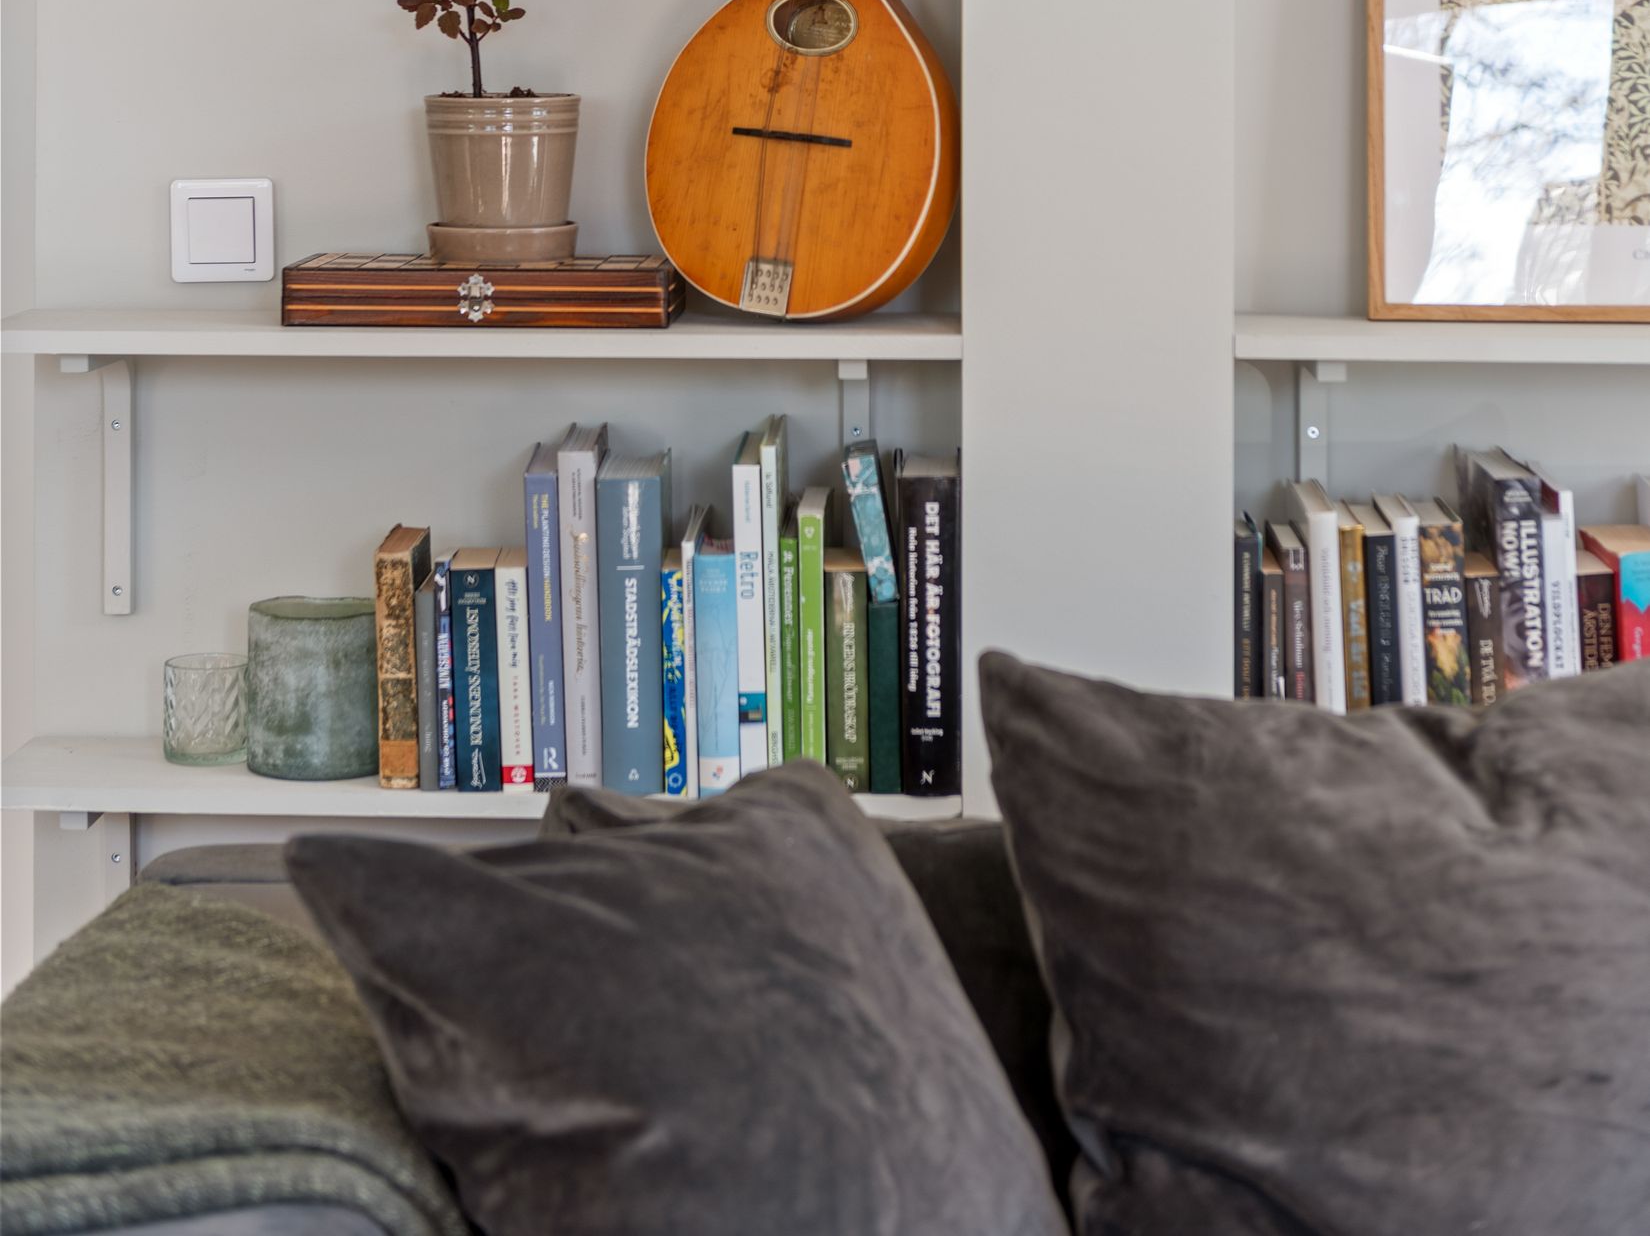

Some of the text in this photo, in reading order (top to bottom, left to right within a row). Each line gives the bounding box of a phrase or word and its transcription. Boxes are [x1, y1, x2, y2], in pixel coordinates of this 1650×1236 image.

[740, 551, 758, 600] Retro
[1502, 519, 1520, 579] NOW!
[925, 501, 944, 718] DET HÄR ÄR FOTOGRAFI
[1424, 584, 1463, 605] TRÄD
[1519, 519, 1545, 668] ILLUSTRATION
[1550, 580, 1564, 669] VILDPLOCKAT
[1598, 603, 1612, 633] DEN
[625, 577, 641, 729] STADSTRÄDSLEXIKON
[471, 678, 483, 746] KONUNGENS
